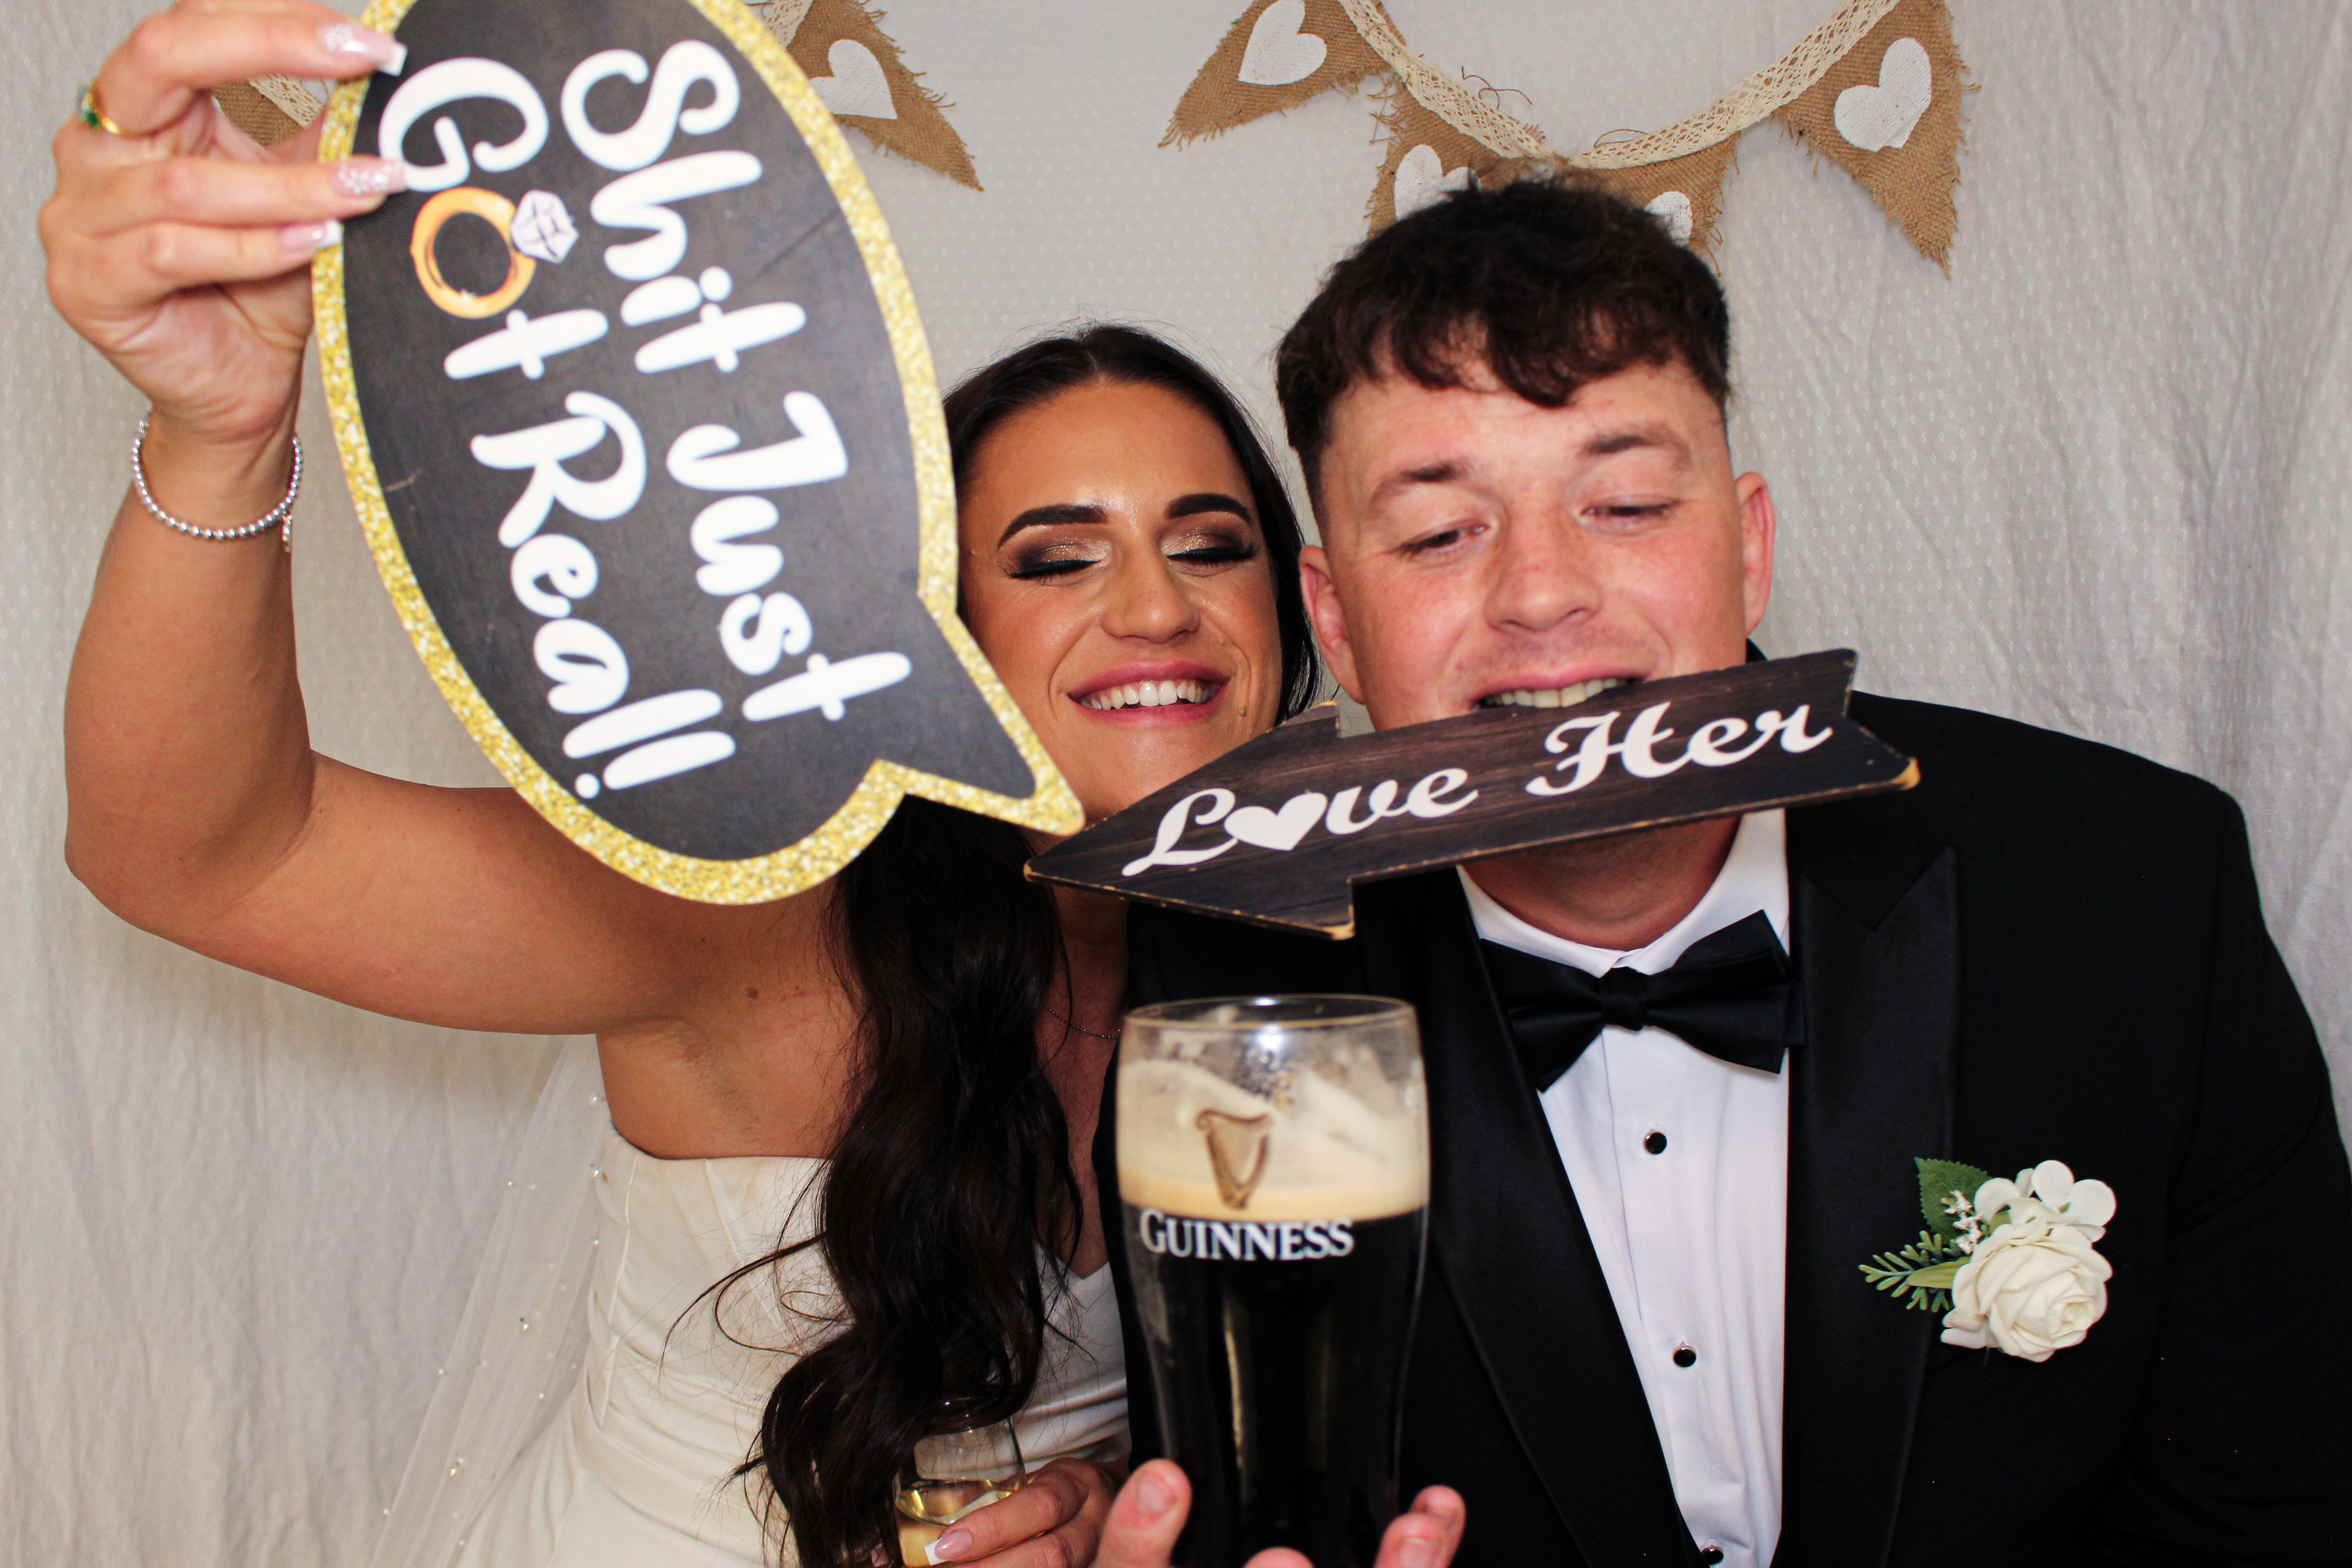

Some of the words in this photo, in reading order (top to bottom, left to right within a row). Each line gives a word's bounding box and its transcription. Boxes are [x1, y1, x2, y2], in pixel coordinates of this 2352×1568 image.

[561, 41, 805, 372] Shit
[471, 391, 735, 798] Real!
[667, 392, 910, 720] Just
[1526, 701, 1832, 796] Her
[1140, 1208, 1354, 1259] GUINNESS
